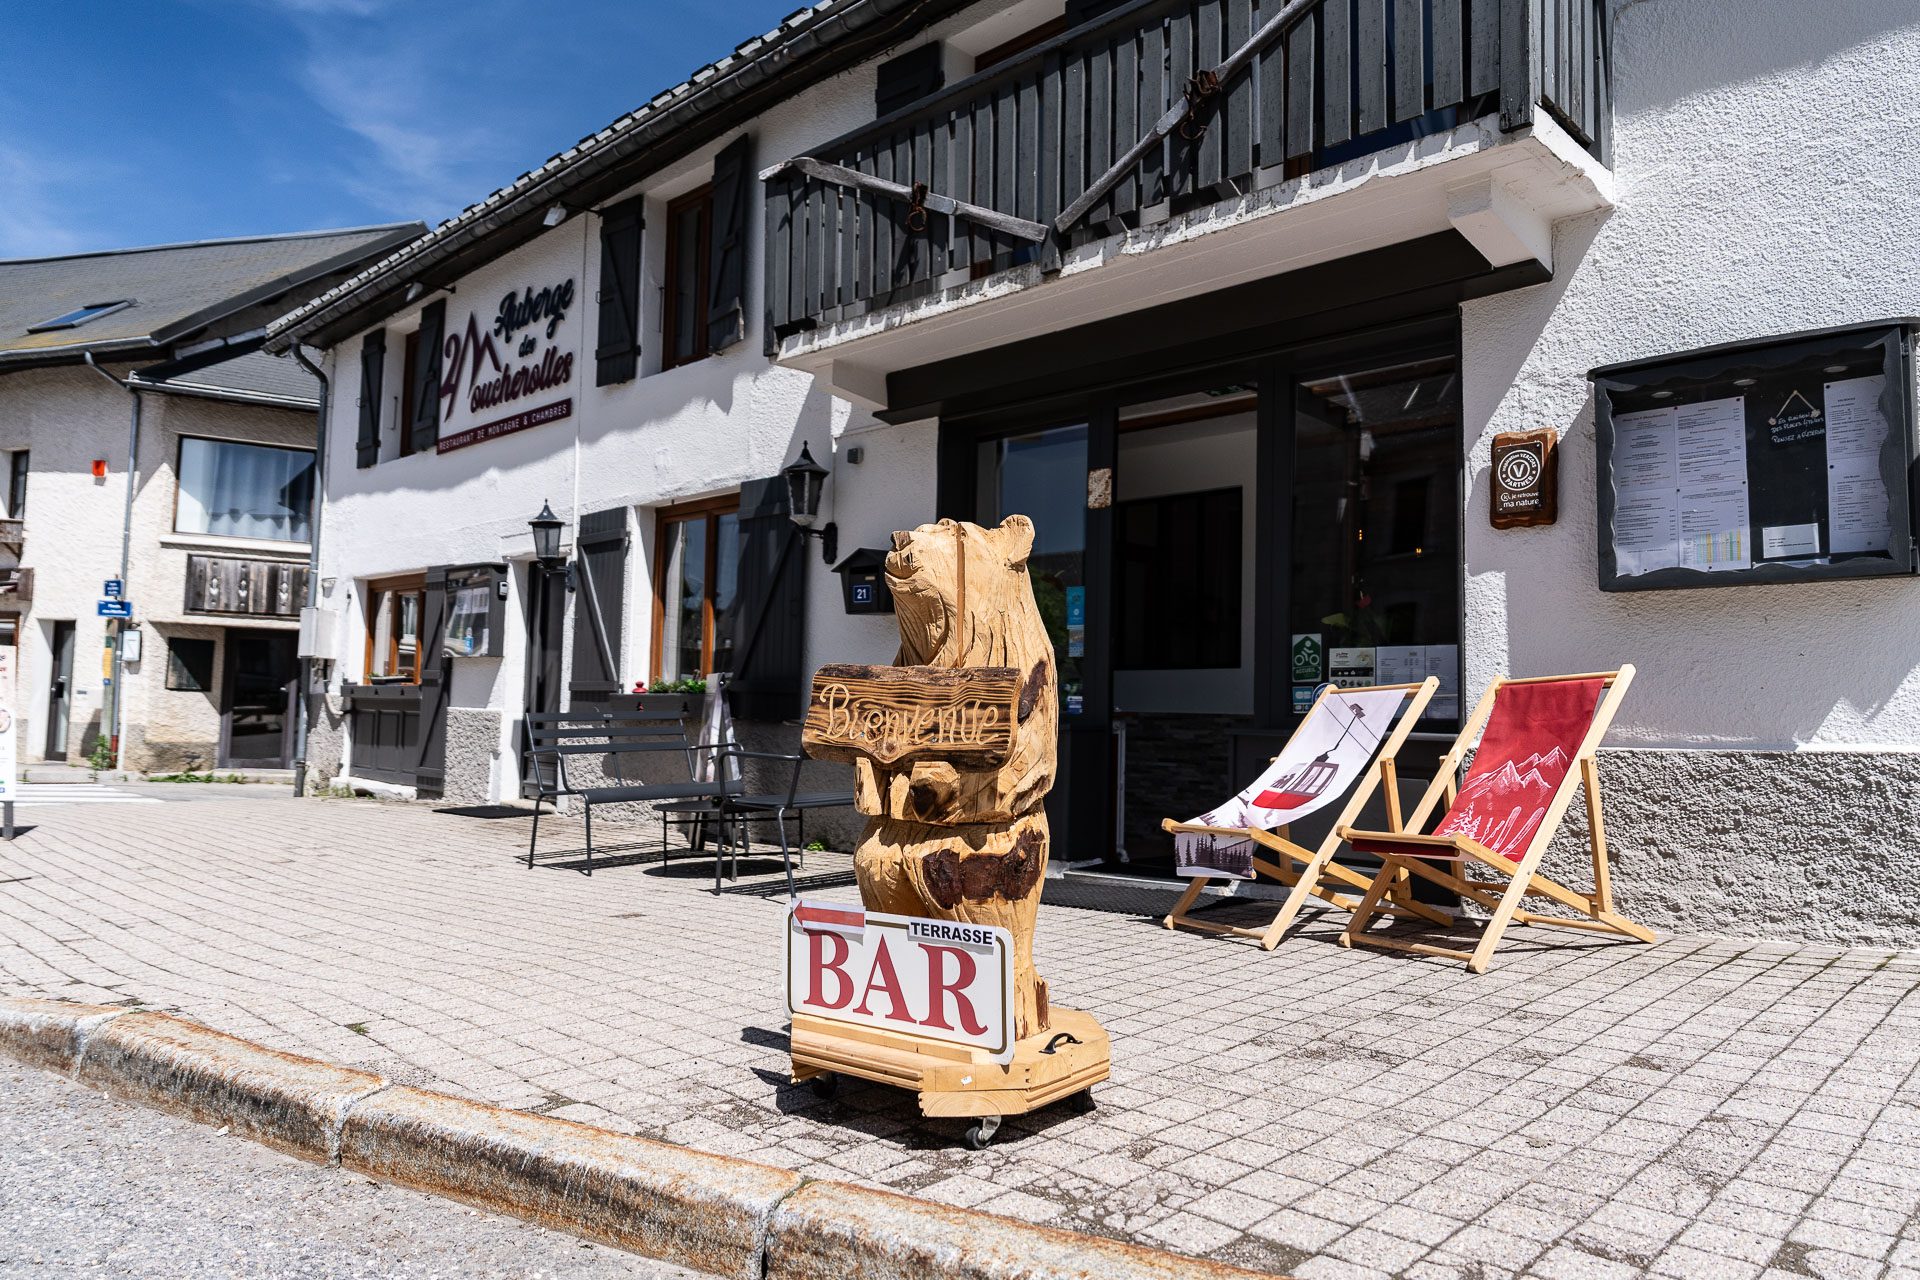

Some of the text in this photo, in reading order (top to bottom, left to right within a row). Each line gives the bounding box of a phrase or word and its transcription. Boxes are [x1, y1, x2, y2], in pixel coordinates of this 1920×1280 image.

[493, 278, 574, 344] Auberge
[518, 334, 537, 358] des
[439, 404, 567, 451] RESTAURANT DE MONTAGNE & CHAMBRES
[1505, 475, 1533, 487] PARTNER
[1513, 463, 1525, 477] V
[1515, 499, 1540, 507] nature
[857, 588, 867, 599] 21
[814, 682, 999, 746] Bienvenue
[910, 920, 994, 945] TERRASSE
[802, 929, 989, 1036] BAR
